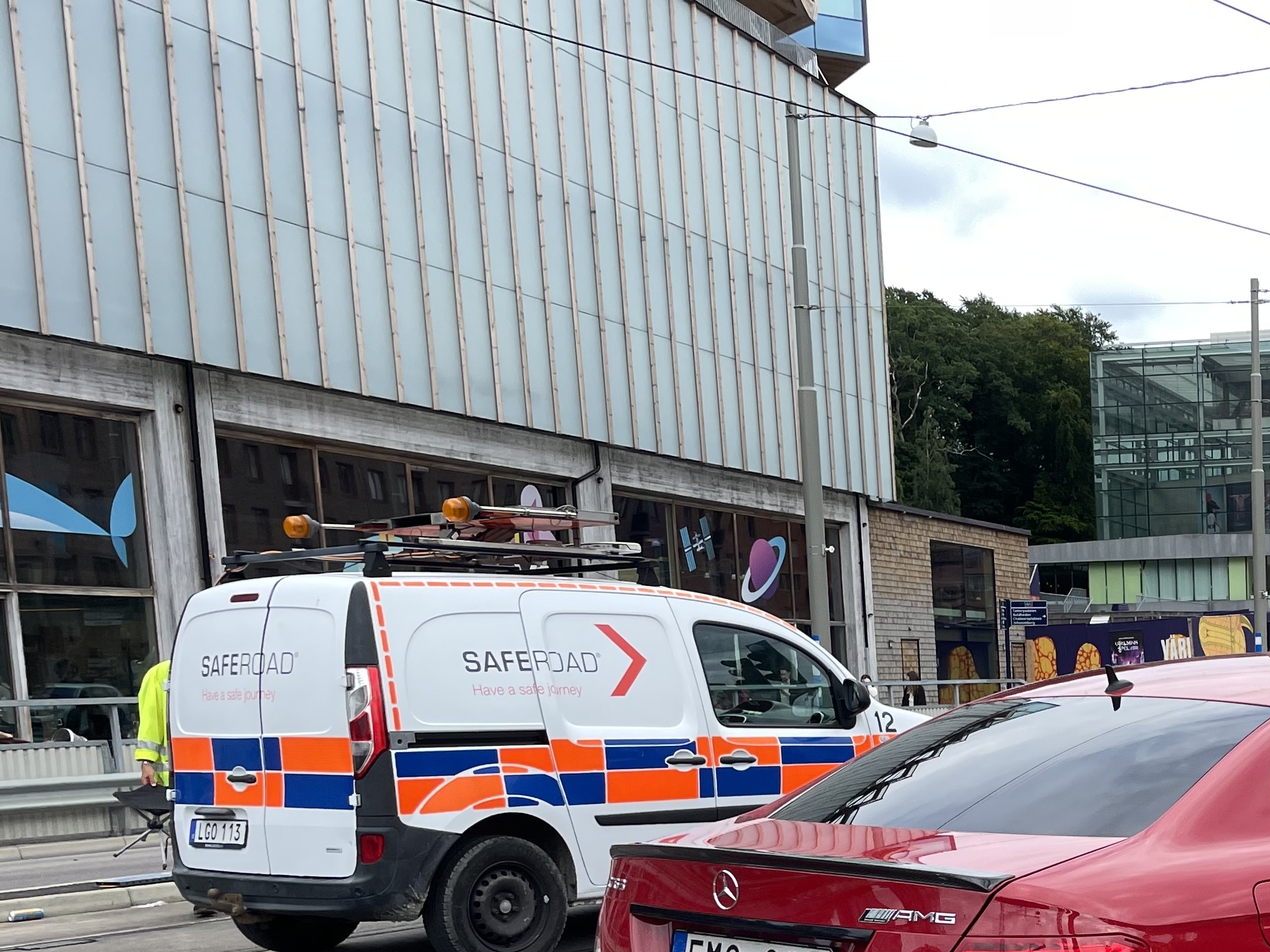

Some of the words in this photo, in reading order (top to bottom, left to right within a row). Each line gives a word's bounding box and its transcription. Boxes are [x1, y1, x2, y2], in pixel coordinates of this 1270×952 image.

[201, 651, 295, 677] SAFEROAD
[462, 650, 599, 673] SAFEROAD
[202, 689, 219, 701] Have
[226, 688, 243, 701] safe
[243, 689, 276, 703] journey
[472, 684, 505, 696] Have
[508, 686, 516, 695] a
[519, 683, 545, 695] safe
[874, 711, 897, 733] 12
[221, 823, 241, 841] 113
[892, 909, 957, 925] AMG
